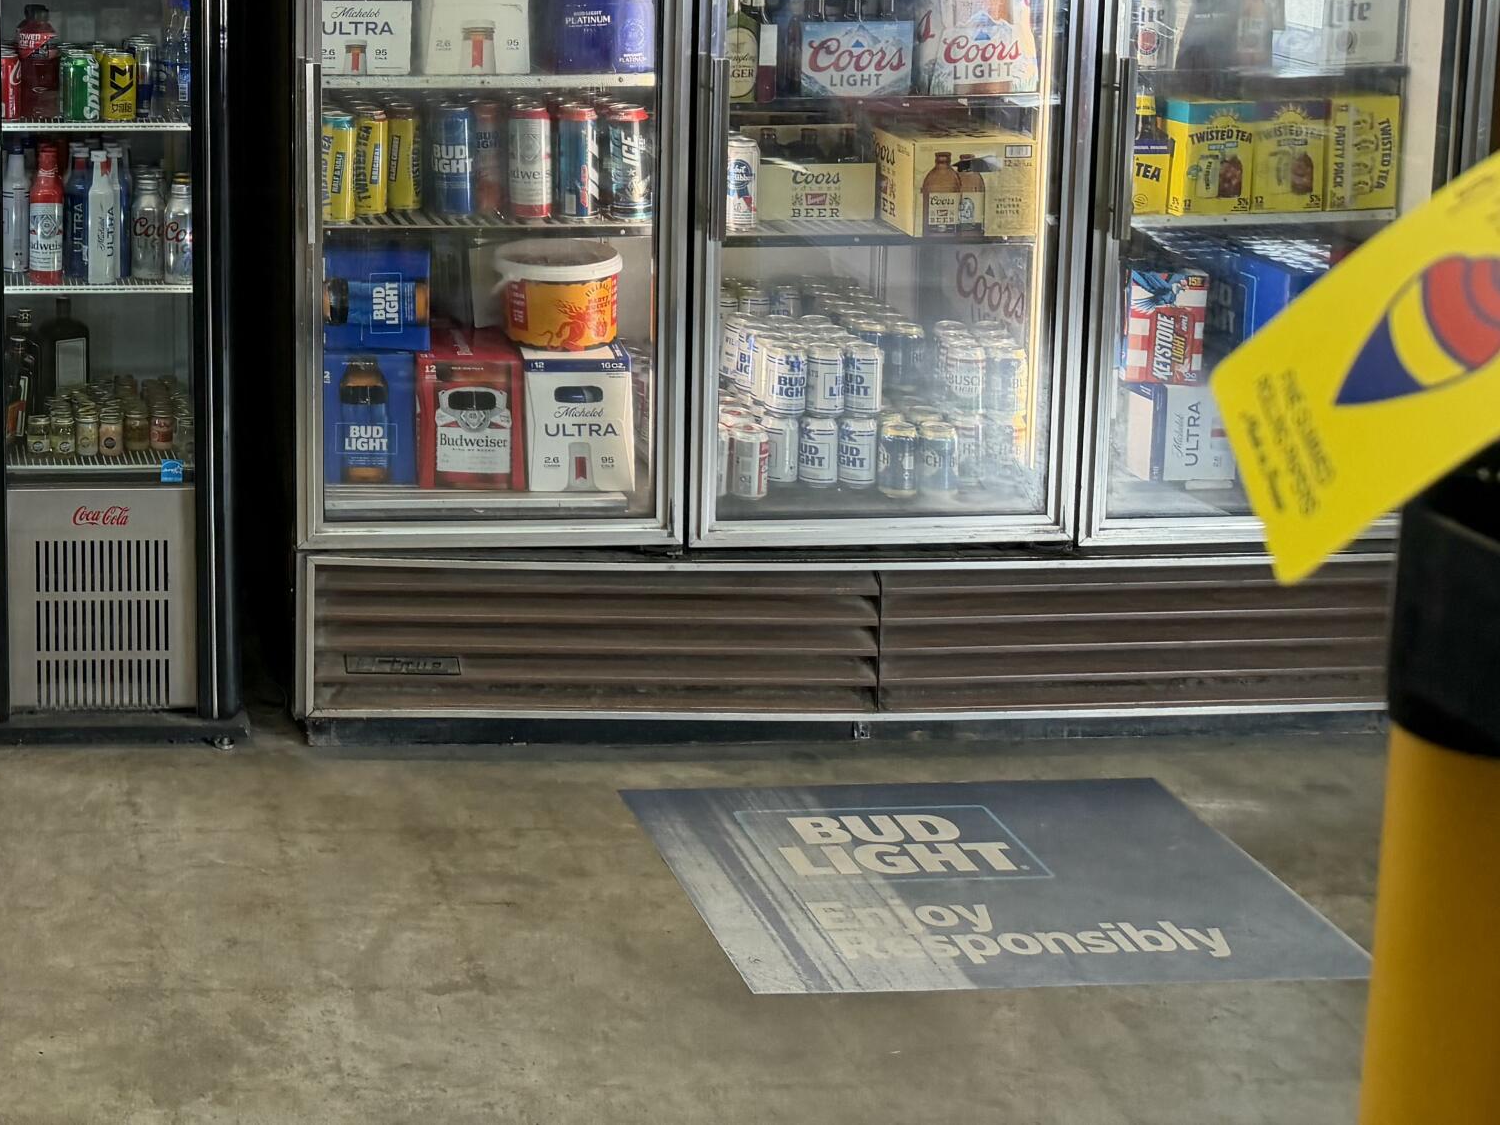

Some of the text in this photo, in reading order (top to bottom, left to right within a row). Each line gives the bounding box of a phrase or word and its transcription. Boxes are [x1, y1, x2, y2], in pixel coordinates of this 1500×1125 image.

[331, 6, 381, 19] Michelob
[565, 15, 611, 25] PLATINUM
[322, 21, 394, 35] ULTRA
[375, 48, 388, 56] 95
[808, 38, 906, 72] Coors
[942, 37, 1022, 64] Coors
[730, 70, 755, 79] GER
[953, 63, 1014, 80] LIGHT
[830, 74, 883, 87] LIGHT
[1189, 129, 1252, 146] TWISTED TEA
[434, 144, 468, 158] BUD
[792, 169, 841, 185] Coors
[1136, 163, 1162, 182] TEA
[882, 197, 896, 218] ER
[930, 195, 955, 206] Coors
[1255, 196, 1263, 204] 12
[792, 208, 840, 218] BEER
[73, 203, 83, 253] ULTRA
[107, 207, 115, 258] ULTRA
[956, 251, 1025, 322] Coors
[373, 286, 386, 320] BUD
[386, 282, 399, 325] LIGHT
[1152, 313, 1175, 381] KEYSTONE
[1171, 335, 1188, 364] LIGHT
[425, 365, 437, 373] 12
[778, 376, 805, 386] BUD
[772, 385, 805, 398] LIGH
[554, 406, 604, 418] Michelob
[350, 426, 383, 438] BUD
[545, 423, 618, 437] ULTRA
[1185, 401, 1200, 467] ULTRA
[344, 438, 388, 451] LIGHT
[439, 433, 508, 449] Budweiser
[800, 443, 819, 456] UD
[839, 444, 861, 456] UD
[800, 456, 825, 468] GHT
[838, 457, 867, 468] GHT
[73, 506, 131, 526] Coca-Cola
[787, 815, 960, 844] BUD
[778, 842, 1019, 875] LIGHT
[805, 900, 994, 934] Enjoy
[828, 921, 1232, 965] Responsibly
